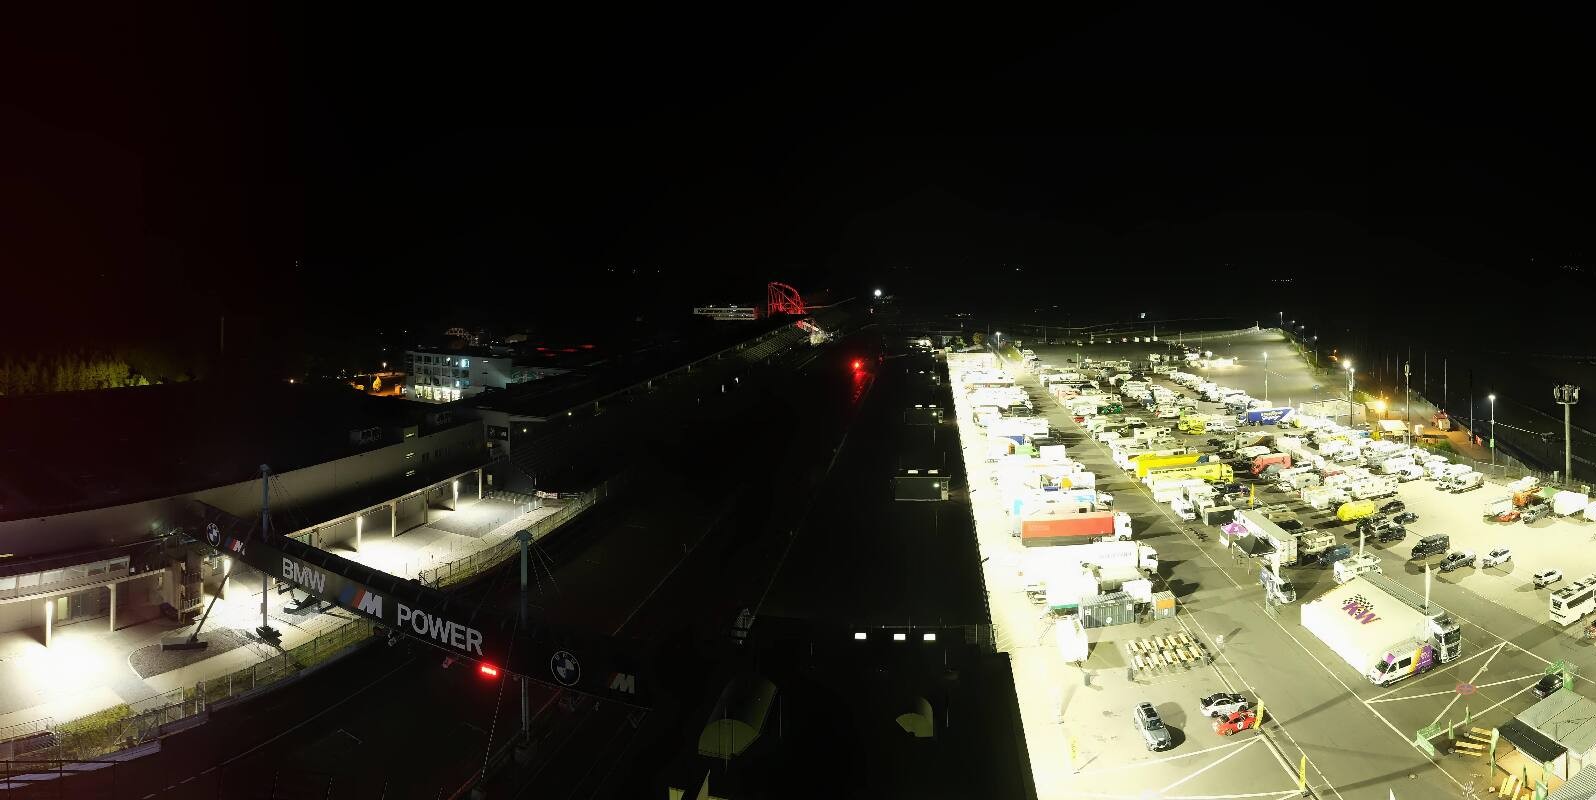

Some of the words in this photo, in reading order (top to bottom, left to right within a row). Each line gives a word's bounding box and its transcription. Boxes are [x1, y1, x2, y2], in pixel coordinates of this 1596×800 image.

[282, 556, 326, 594] BMW
[396, 602, 484, 657] POWER
[1341, 601, 1377, 625] KW
